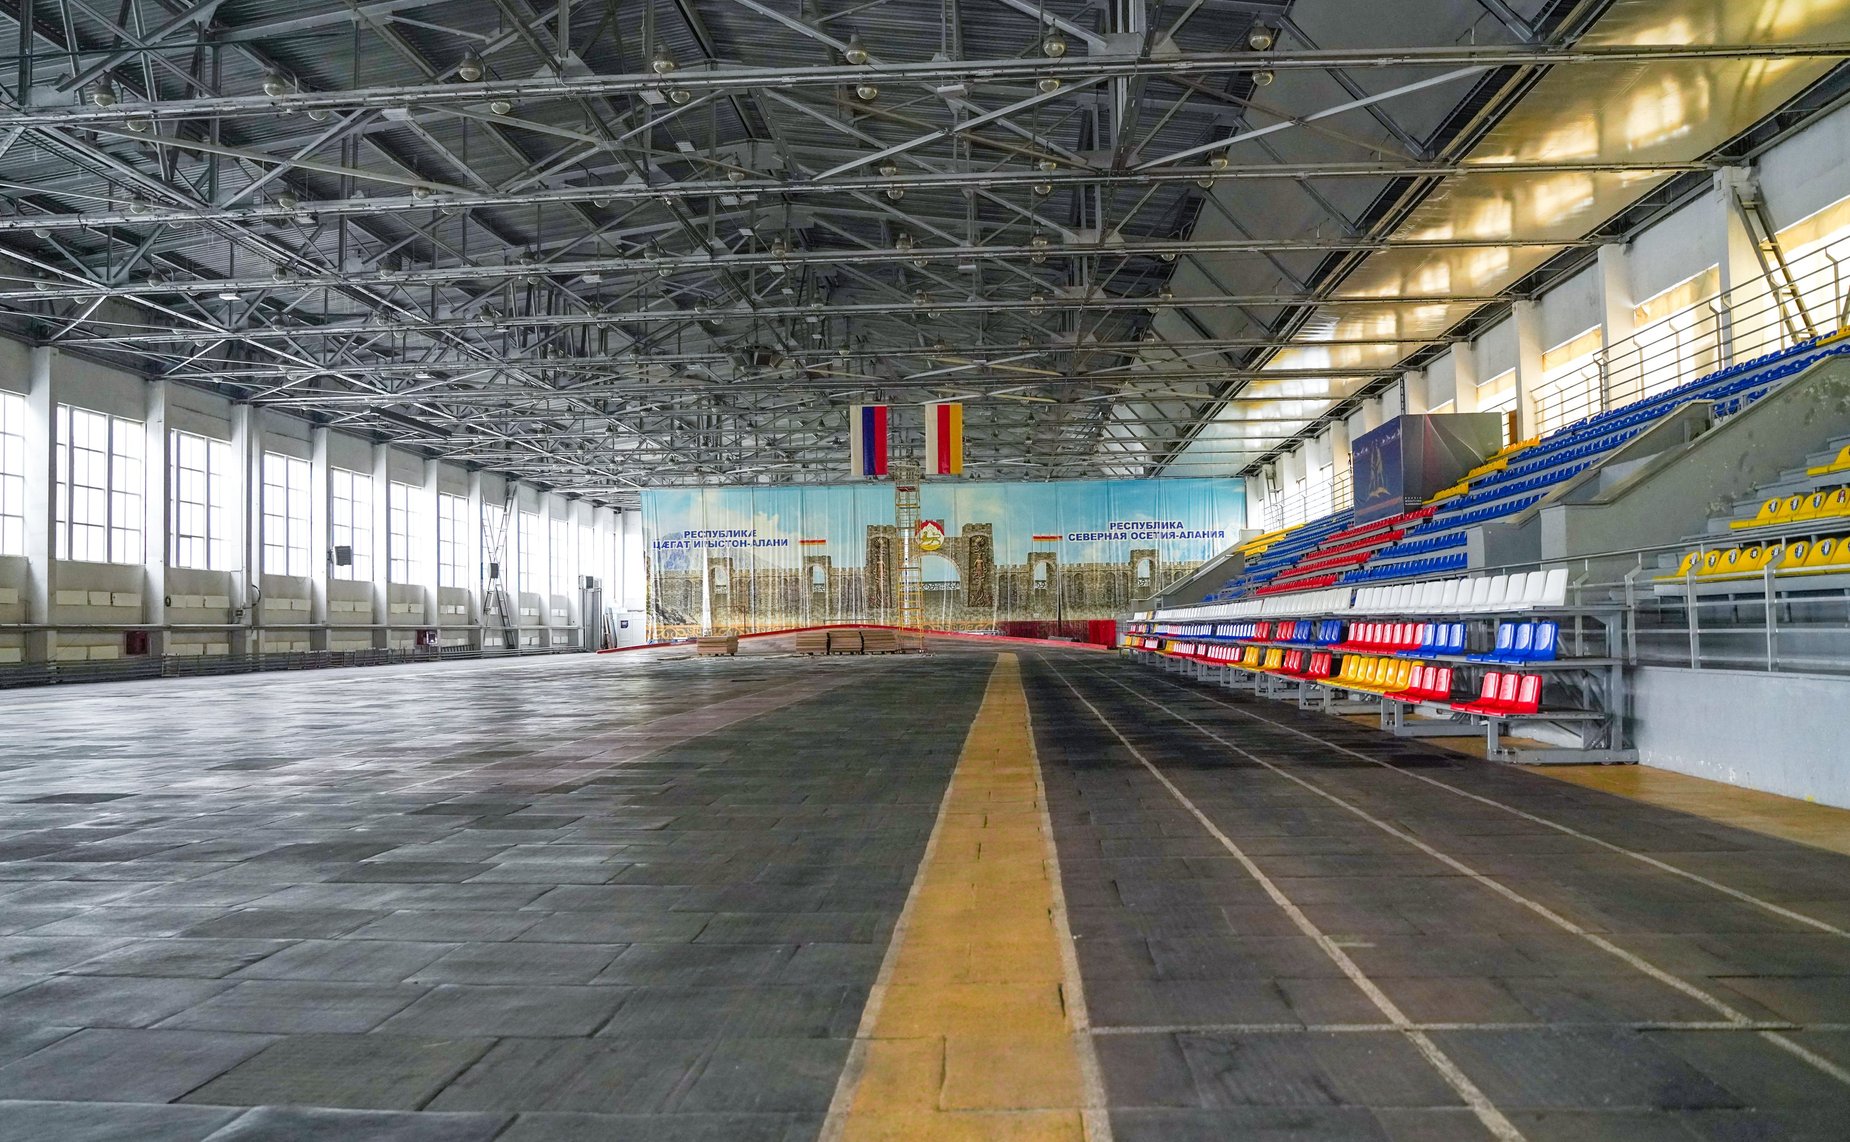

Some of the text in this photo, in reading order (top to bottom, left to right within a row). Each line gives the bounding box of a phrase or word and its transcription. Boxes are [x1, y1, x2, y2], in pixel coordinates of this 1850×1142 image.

[1109, 521, 1184, 531] РЕСПУБЛИКА
[1068, 531, 1225, 542] СЕВЕРНАЯ ОСЕТИЯ-АЛАНИЯ
